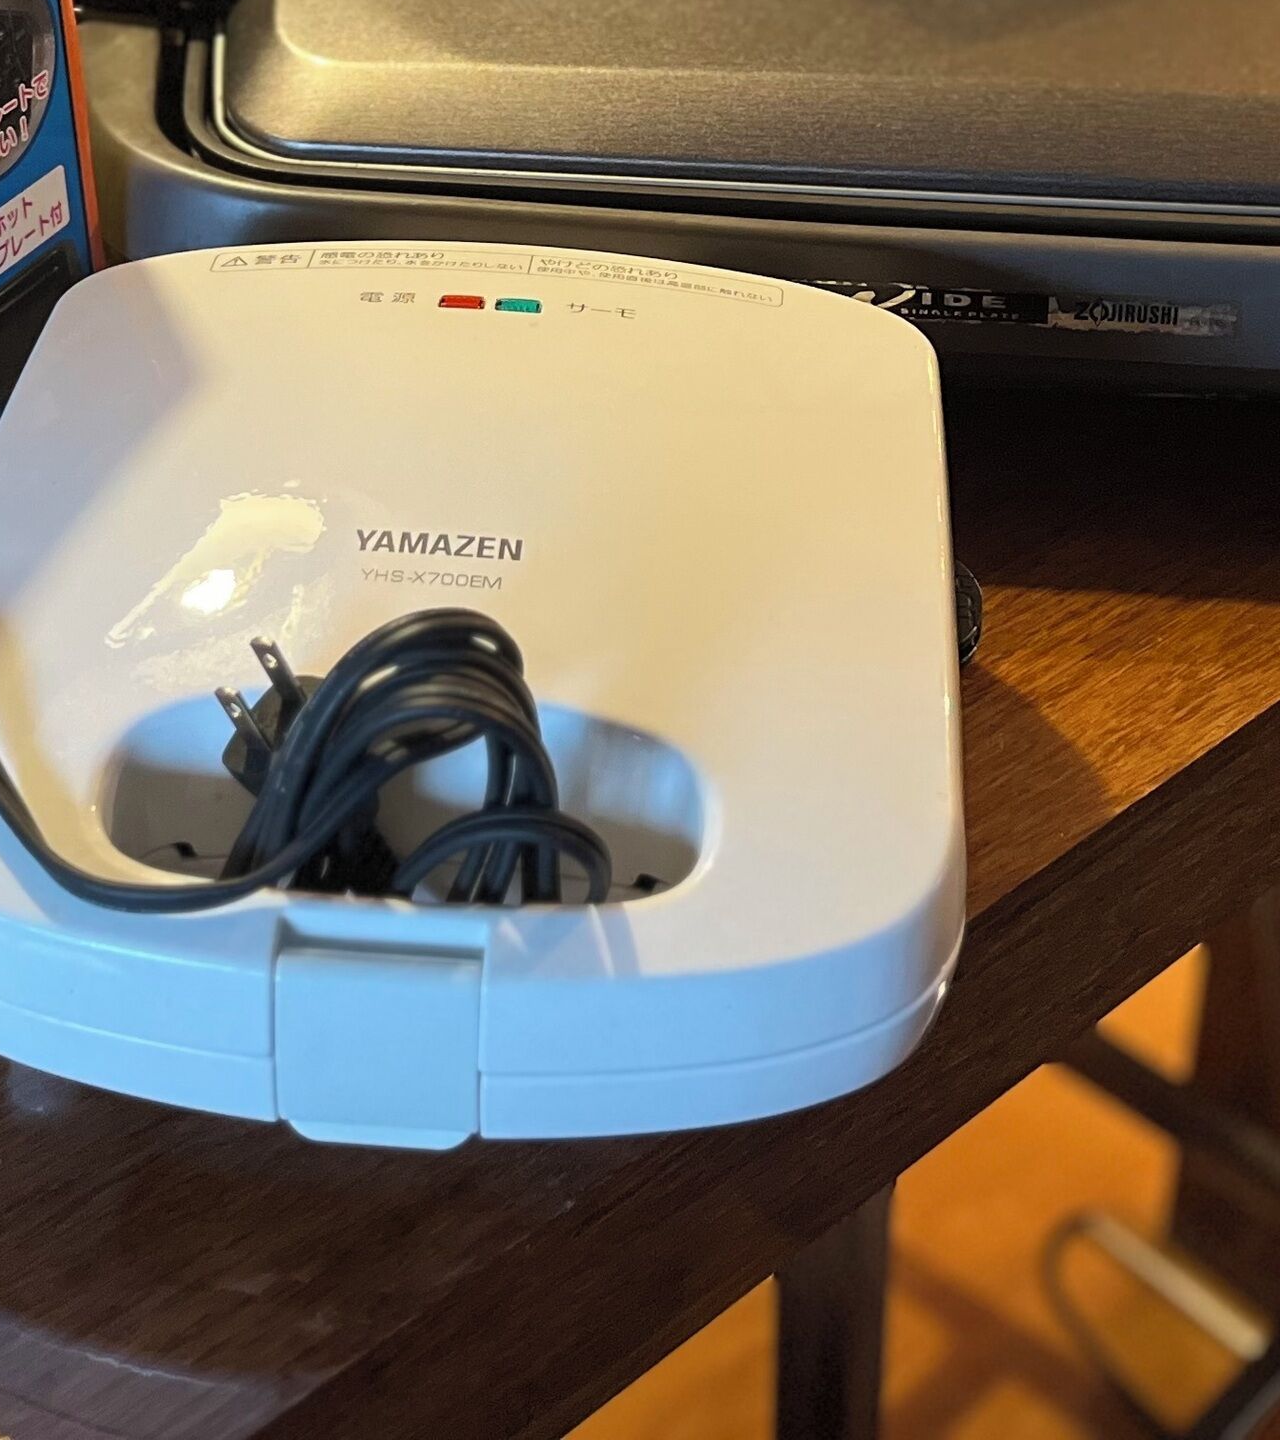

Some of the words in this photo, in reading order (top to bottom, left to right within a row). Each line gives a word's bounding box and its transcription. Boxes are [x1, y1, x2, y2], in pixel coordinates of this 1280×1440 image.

[254, 253, 302, 265] 警告
[566, 302, 637, 320] サーモ
[1073, 298, 1180, 327] ZOJIRUSHI
[356, 528, 523, 561] YAMAZEN
[360, 567, 503, 591] YHS-X700EM
